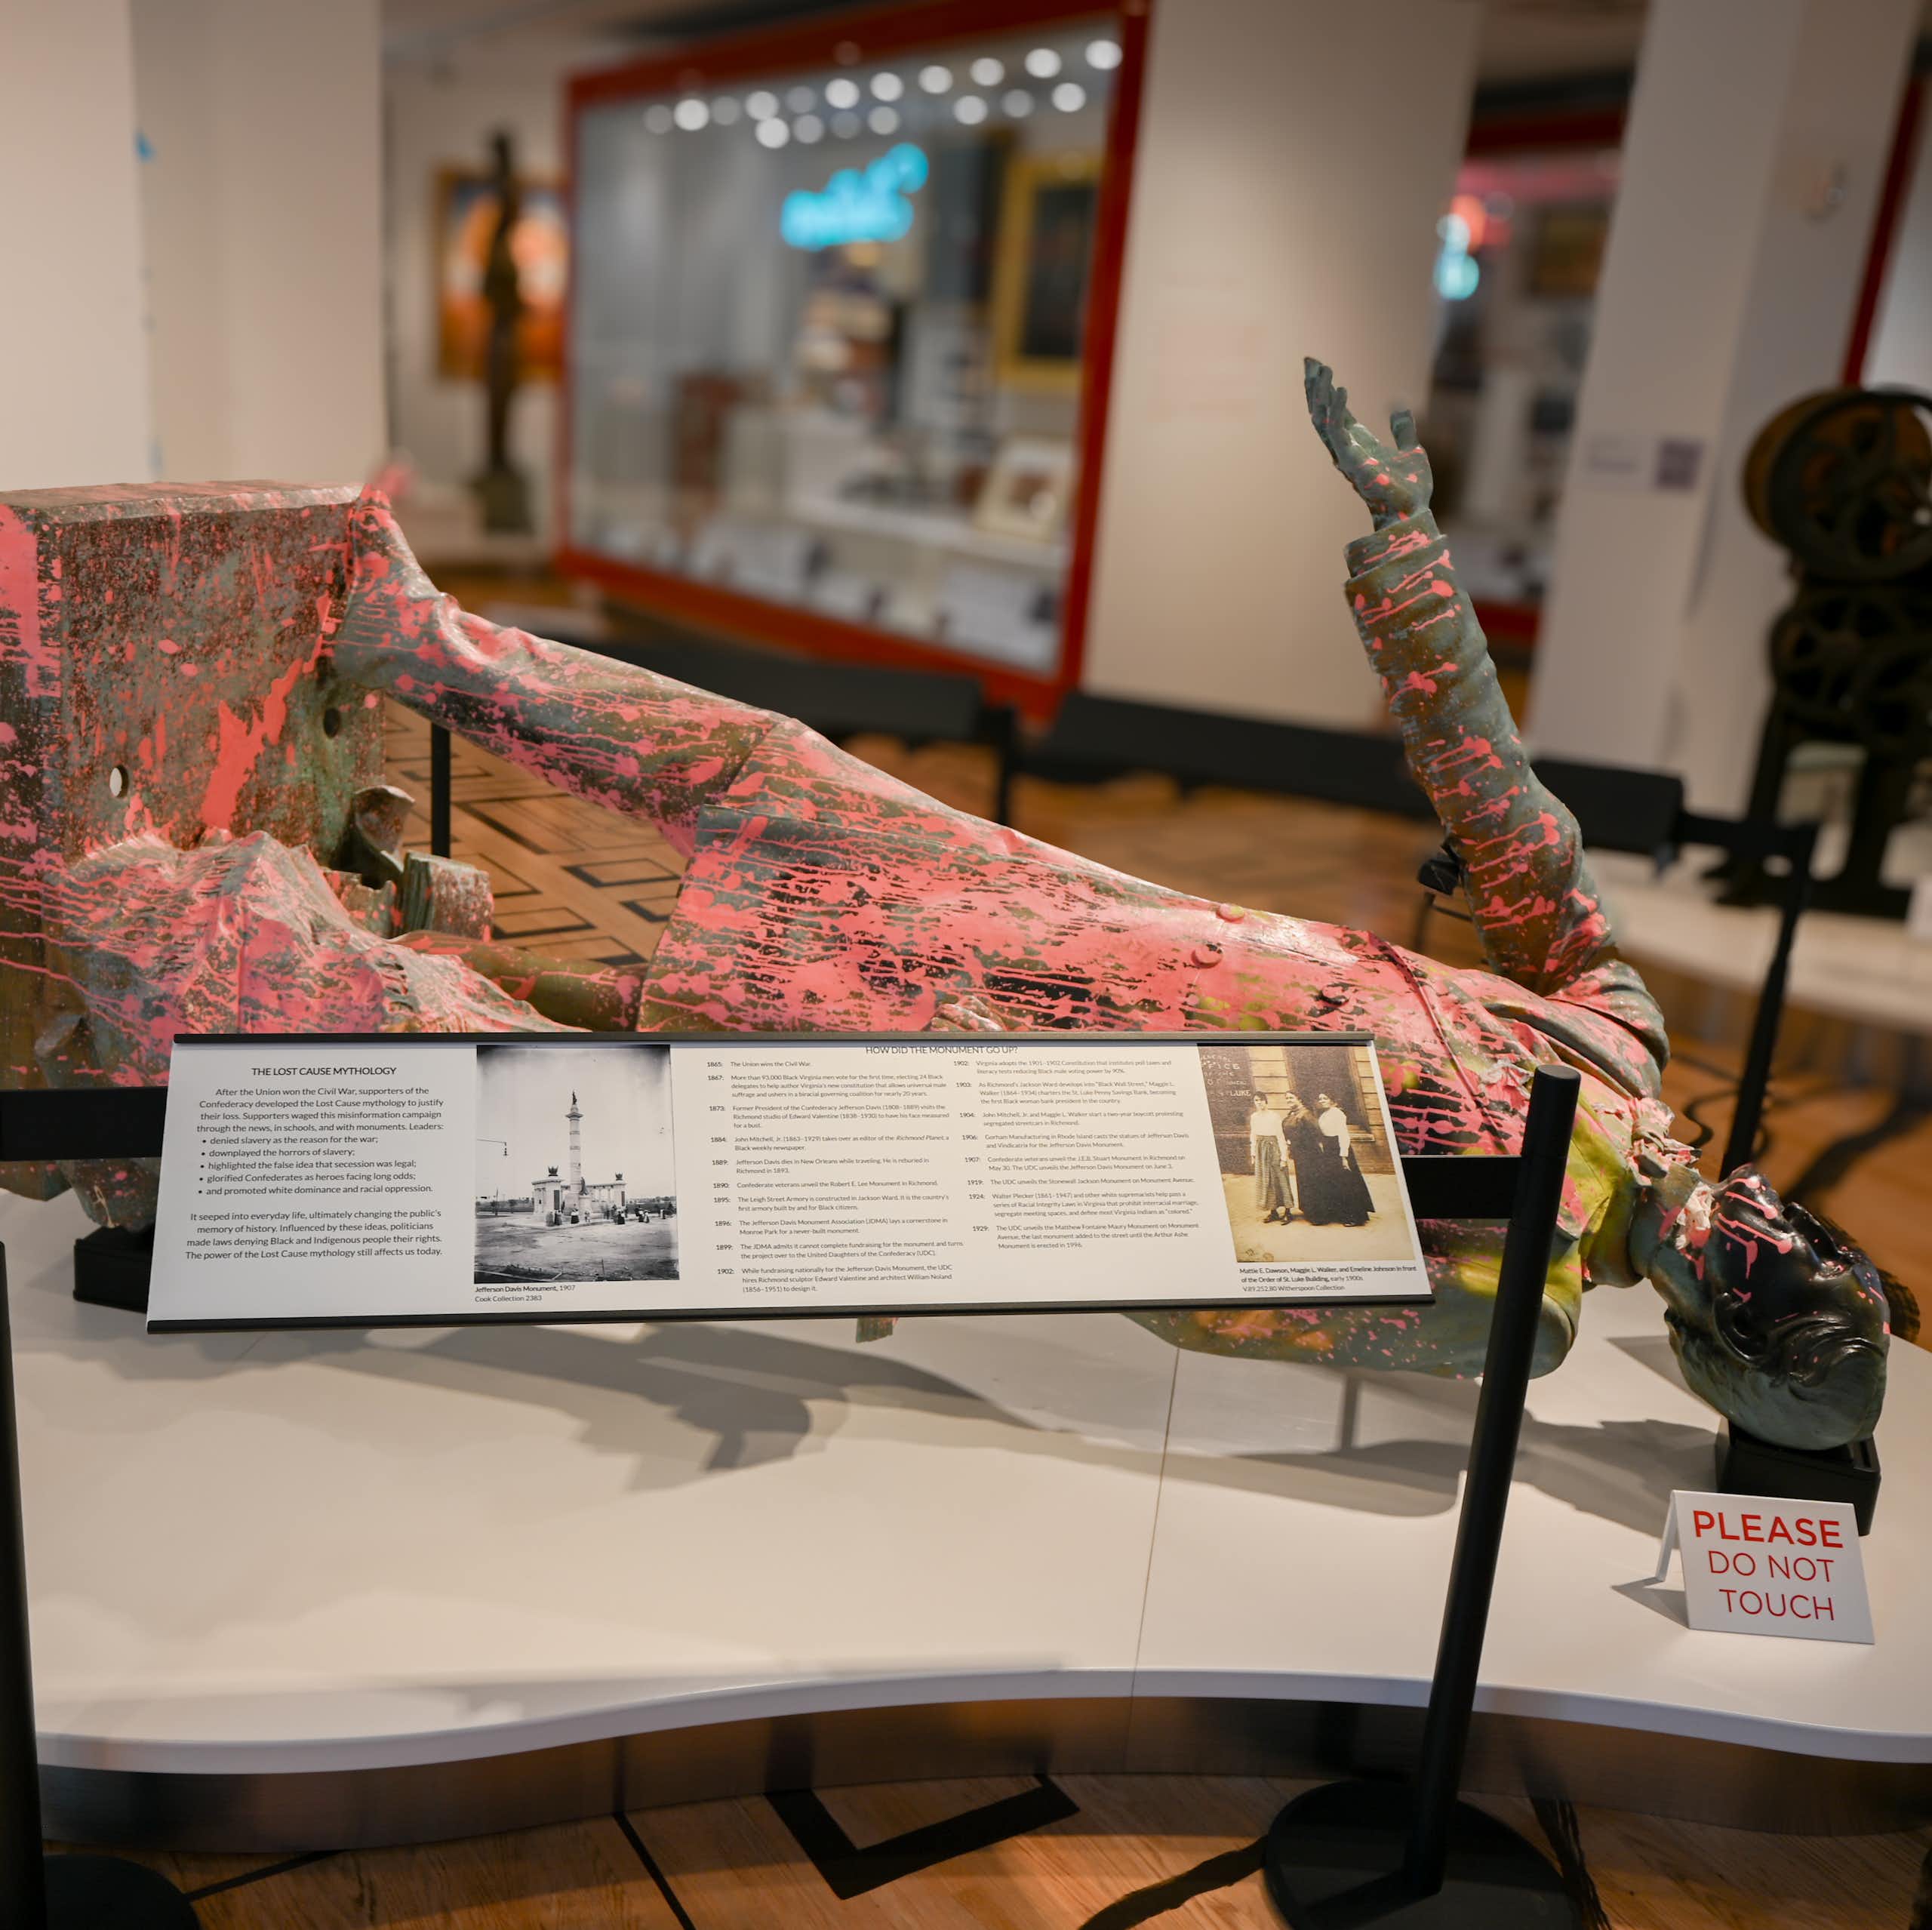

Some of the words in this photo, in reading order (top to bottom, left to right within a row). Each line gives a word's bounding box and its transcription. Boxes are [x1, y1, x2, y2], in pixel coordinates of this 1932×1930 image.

[299, 1067, 331, 1076] CAUSE
[337, 1087, 357, 1096] War,
[358, 1087, 404, 1097] supporters
[199, 1100, 254, 1110] Confederacy
[254, 1100, 298, 1110] developed
[362, 1099, 406, 1109] mythology
[417, 1099, 444, 1108] justify
[242, 1112, 289, 1122] Supporters
[291, 1112, 318, 1121] waged
[401, 1110, 441, 1120] campaign
[197, 1125, 230, 1134] through
[283, 1124, 317, 1132] schools,
[241, 1137, 271, 1146] slavery
[209, 1149, 261, 1159] downplayed
[322, 1148, 355, 1158] slavery;
[208, 1162, 256, 1171] highlighted
[394, 1159, 416, 1169] legal;
[207, 1174, 243, 1184] glorified
[245, 1173, 303, 1181] Confederates
[346, 1172, 371, 1182] facing
[374, 1172, 391, 1181] long
[392, 1172, 415, 1180] odds;
[224, 1187, 266, 1196] promoted
[268, 1186, 293, 1194] white
[385, 1184, 432, 1194] oppression.
[198, 1213, 229, 1222] seeped
[250, 1212, 290, 1221] everyday
[291, 1211, 307, 1220] life,
[309, 1211, 352, 1220] ultimately
[353, 1211, 392, 1220] changing
[409, 1210, 441, 1219] public's
[245, 1225, 277, 1234] history.
[327, 1224, 337, 1233] by
[365, 1224, 388, 1232] ideas,
[390, 1223, 433, 1233] politicians
[213, 1238, 232, 1246] laws
[233, 1238, 268, 1248] denying
[314, 1236, 361, 1246] Indigenous
[362, 1236, 391, 1245] people
[415, 1236, 441, 1245] rights.
[309, 1249, 355, 1259] mythology
[417, 1248, 442, 1257] today.
[1693, 1510, 1844, 1548] PLEASE
[1708, 1550, 1756, 1576] DO
[1768, 1555, 1835, 1582] NOT
[1719, 1589, 1835, 1621] TOUCH
